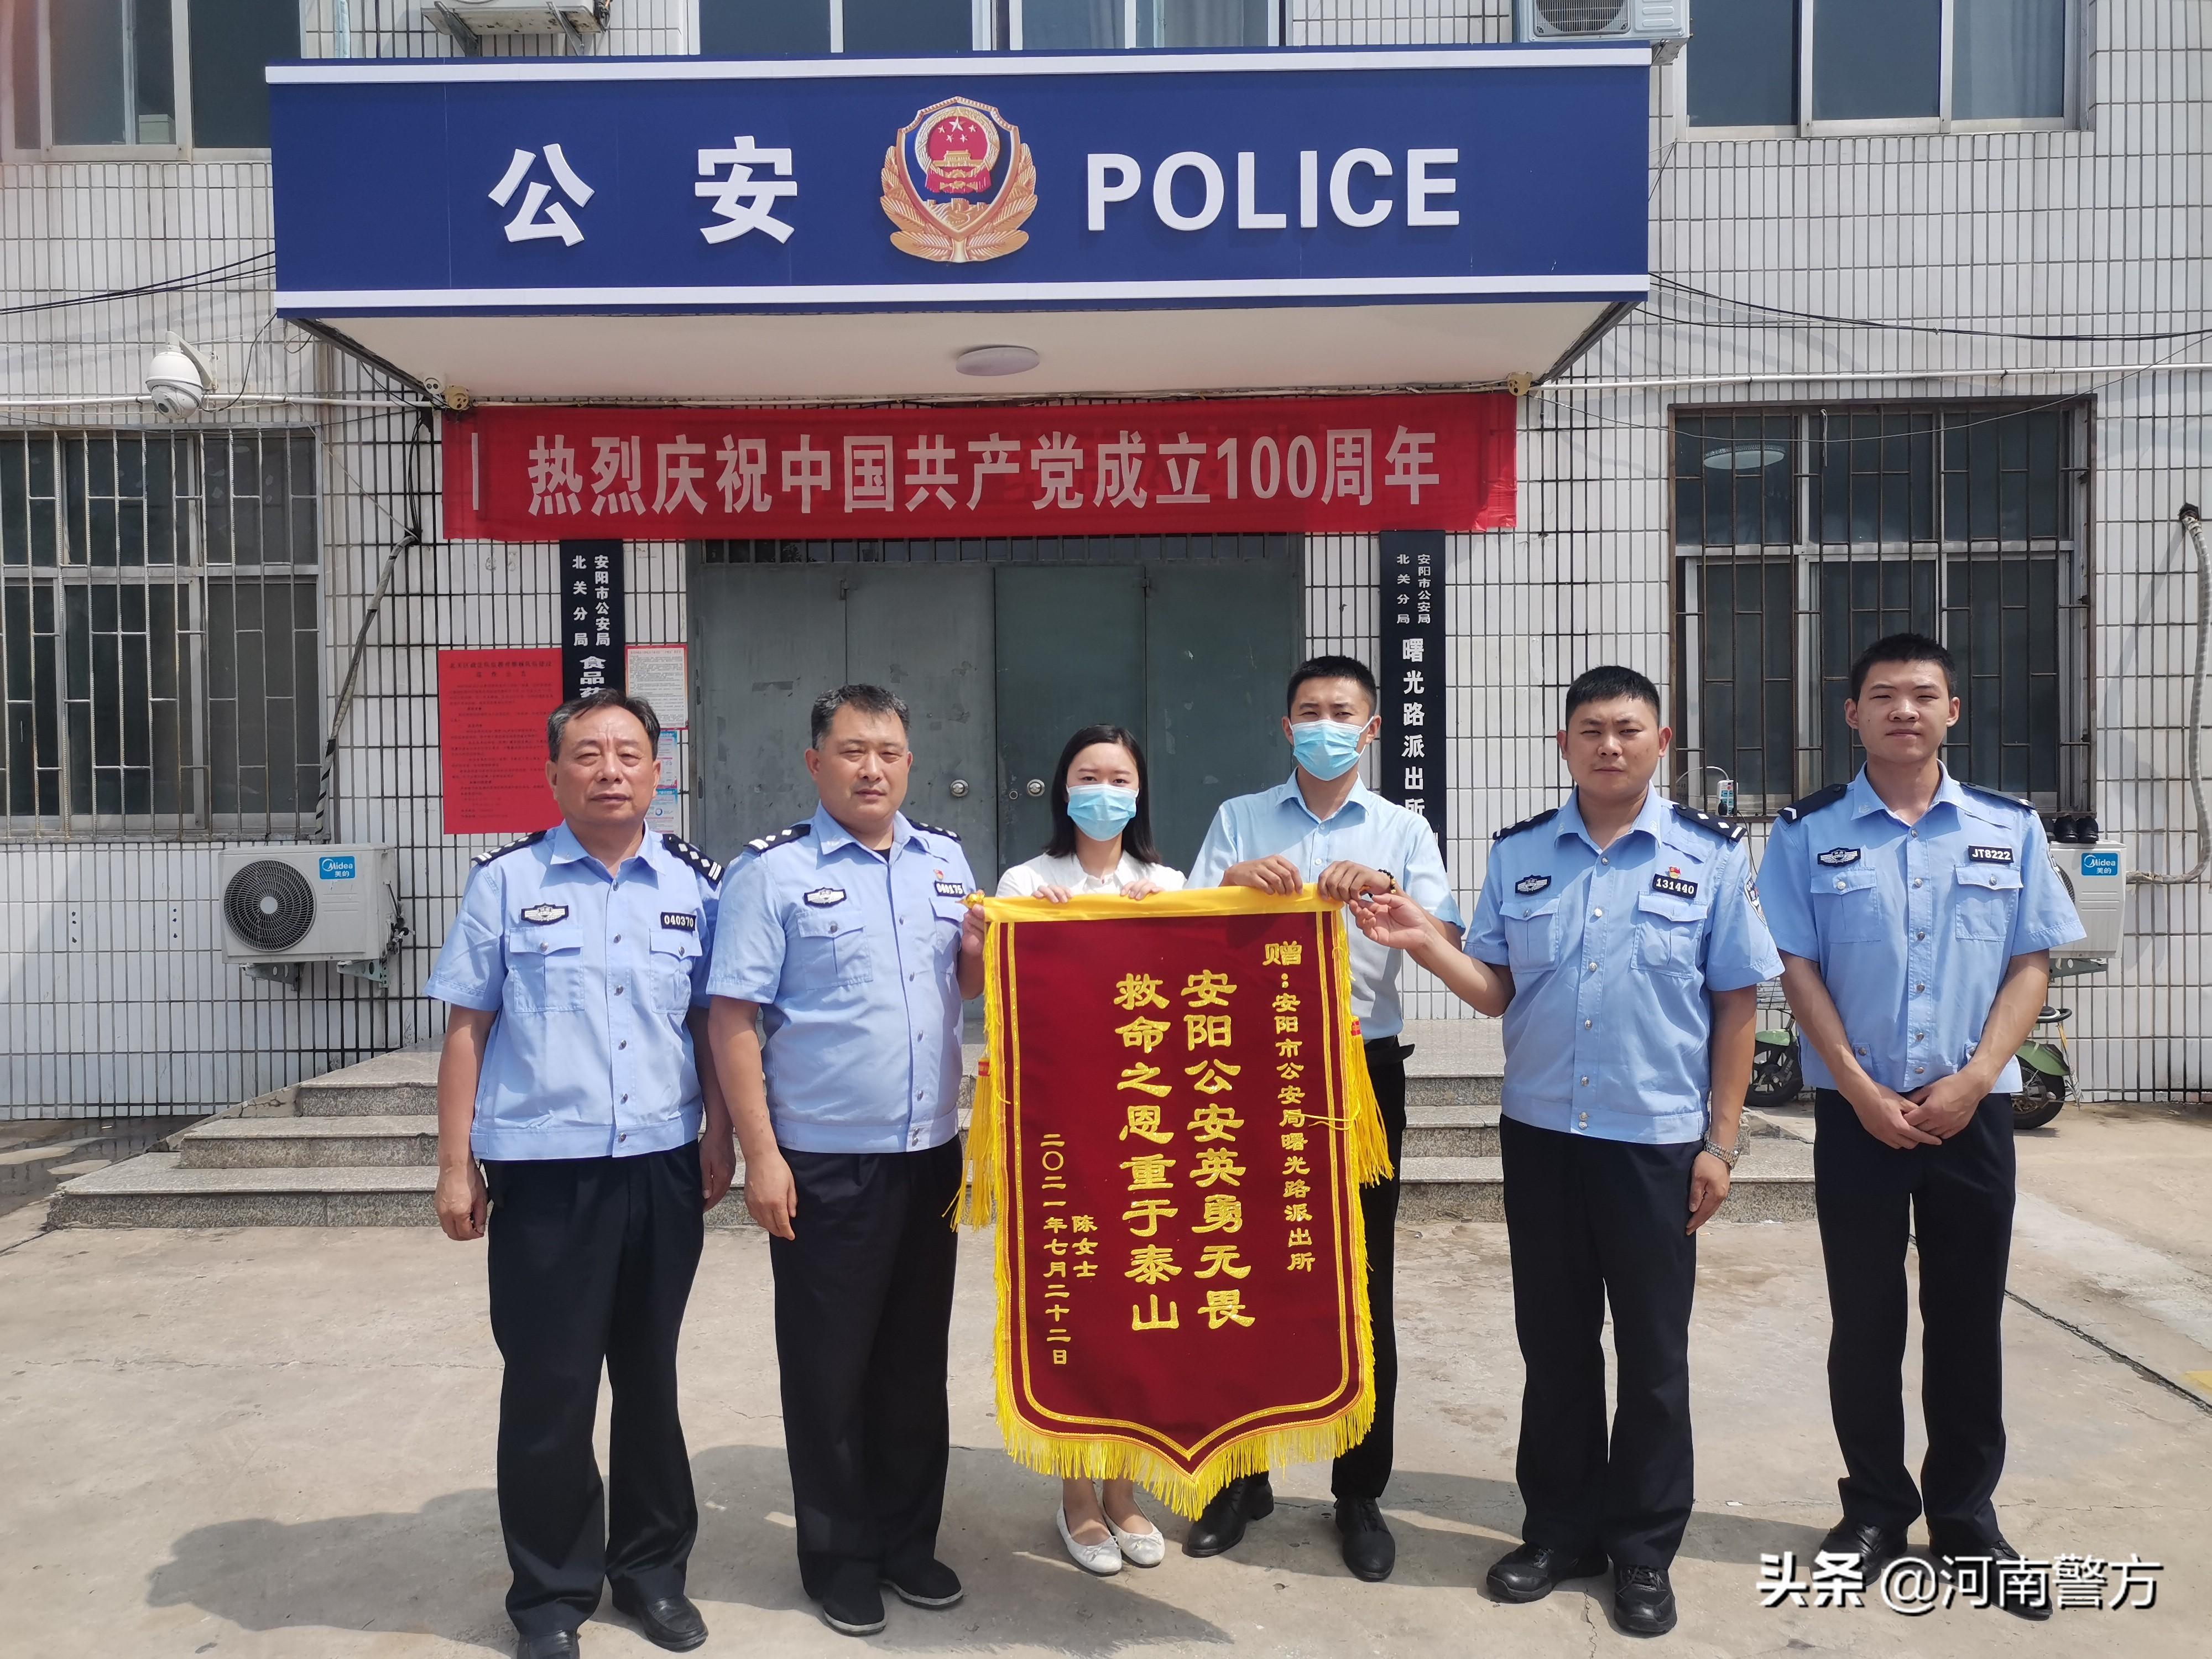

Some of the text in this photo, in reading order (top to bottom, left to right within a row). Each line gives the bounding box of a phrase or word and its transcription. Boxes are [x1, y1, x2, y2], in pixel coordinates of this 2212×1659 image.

[488, 136, 797, 246] 公安
[1088, 148, 1459, 231] POLICE
[528, 425, 1440, 517] 热烈庆祝中国共产党成立100周年
[572, 555, 588, 646] 北关分局
[594, 555, 610, 646] 安阳市公安局
[1397, 554, 1411, 624] 北关分局
[1417, 554, 1431, 624] 安阳市公安局
[1401, 638, 1426, 815] 曙光路派出所
[322, 859, 353, 871] Midea
[1656, 878, 1694, 895] 131440
[1971, 849, 2011, 860] JT8222
[2084, 855, 2116, 867] Midea
[664, 915, 694, 928] 040370
[1114, 973, 1182, 1331] 救命之恩重于泰山
[1181, 969, 1256, 1329] 安阳公安英勇无畏
[1072, 1215, 1098, 1277] 陈女士
